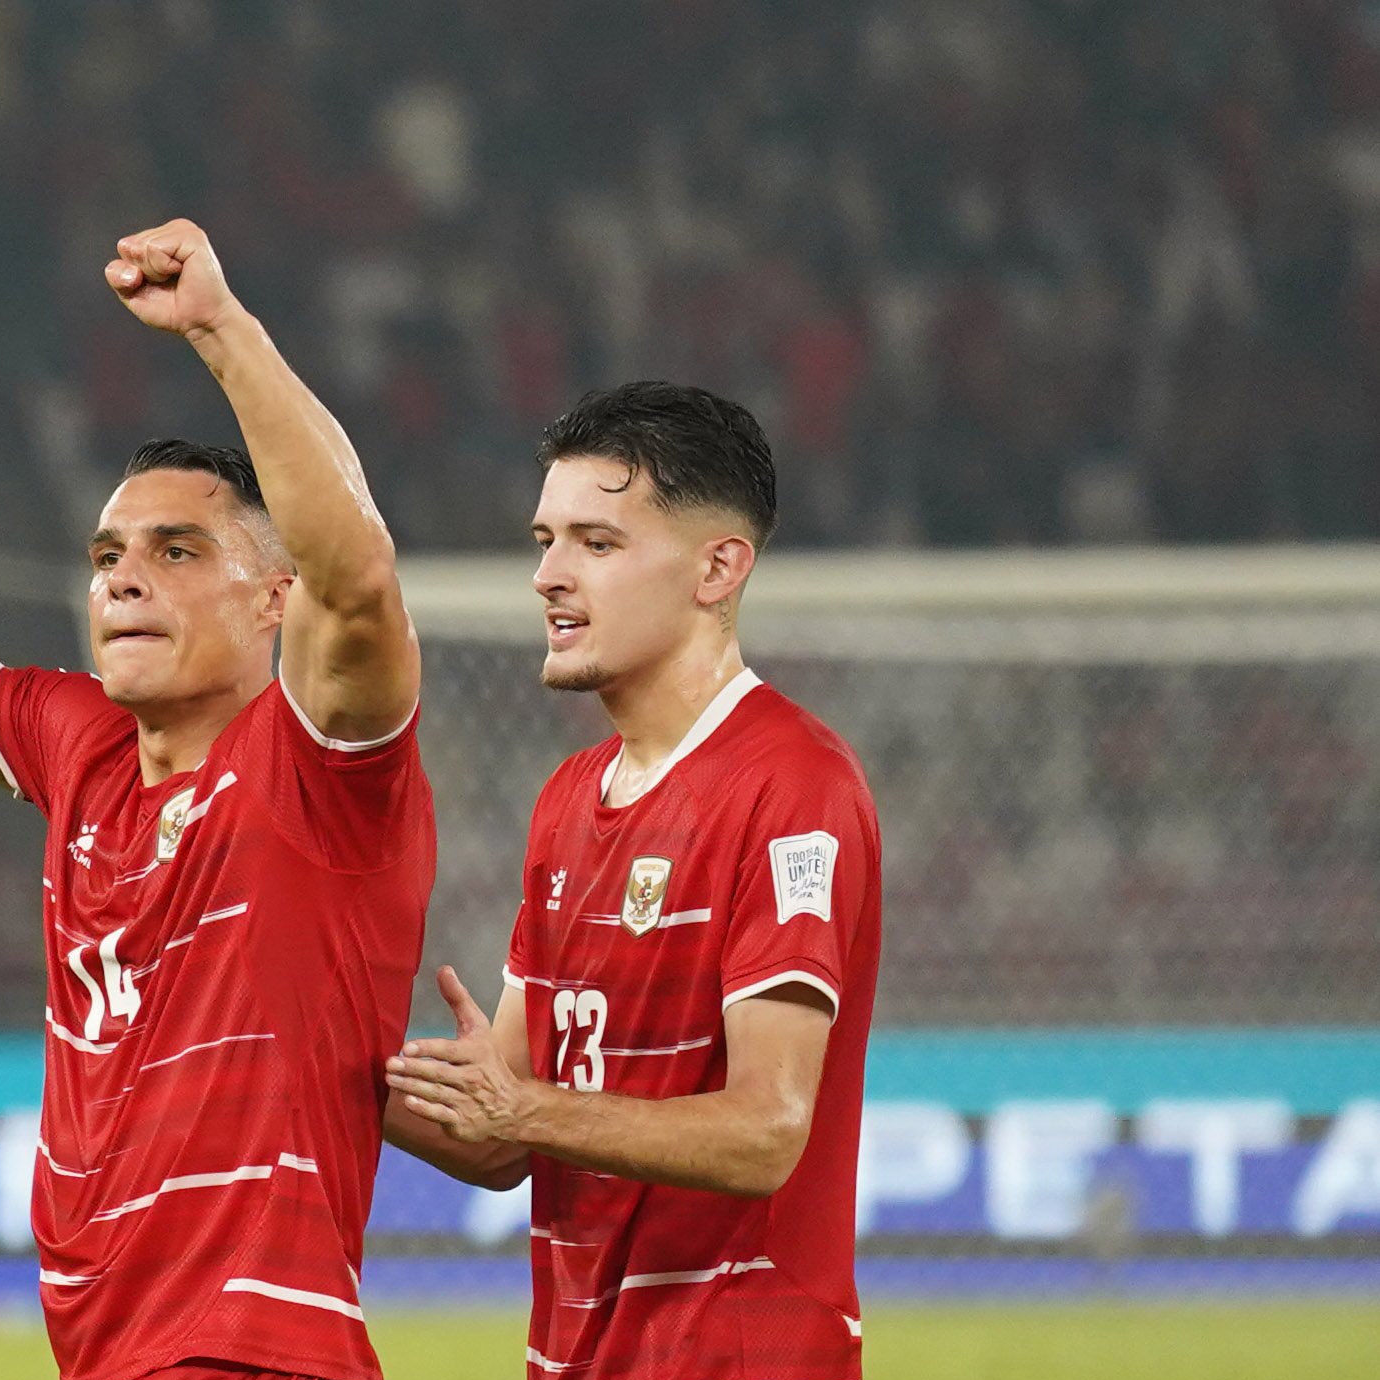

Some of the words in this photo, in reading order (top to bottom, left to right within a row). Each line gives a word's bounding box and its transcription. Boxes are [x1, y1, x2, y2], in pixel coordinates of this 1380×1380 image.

[788, 858, 826, 882] UNTES
[68, 926, 142, 1041] 14
[553, 989, 608, 1092] 23
